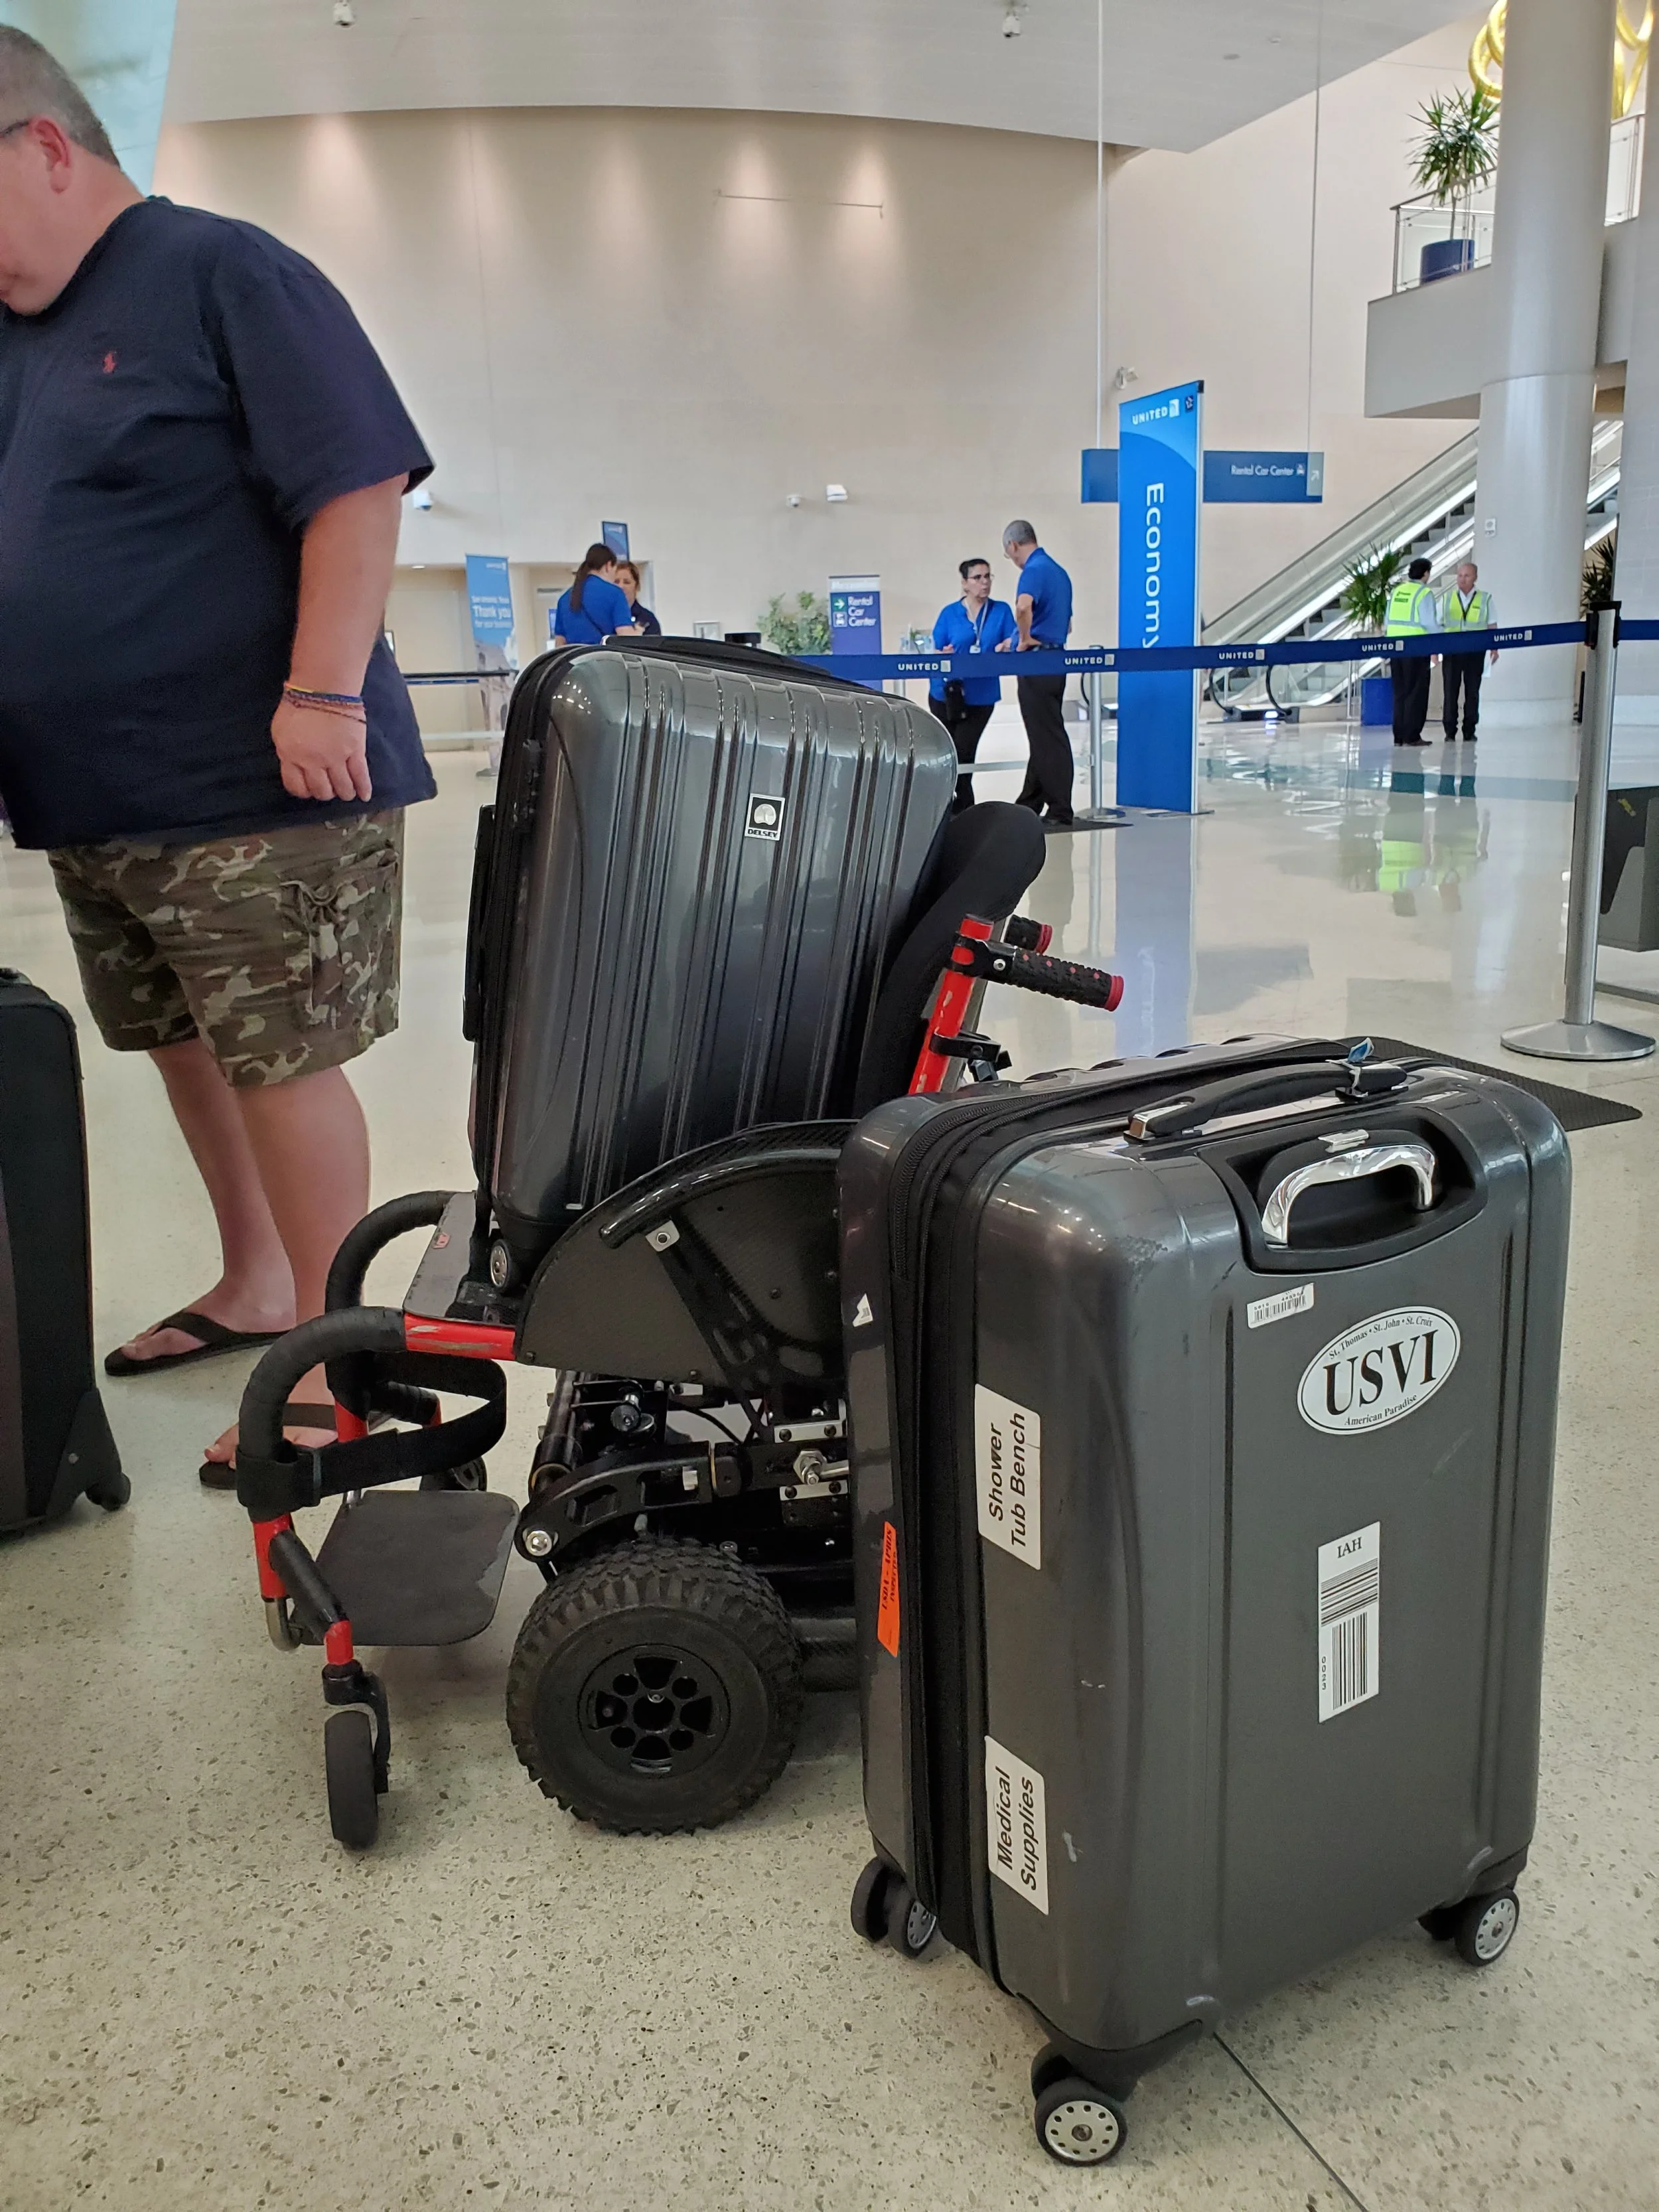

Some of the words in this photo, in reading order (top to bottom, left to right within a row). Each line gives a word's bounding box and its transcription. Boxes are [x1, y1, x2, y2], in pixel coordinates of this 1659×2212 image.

[1132, 406, 1168, 425] UNITED
[1231, 465, 1254, 475] Rental
[1255, 465, 1269, 476] Car
[1270, 465, 1293, 476] Center
[1142, 482, 1164, 648] Economy
[847, 595, 873, 606] Rental
[848, 607, 865, 617] Car
[849, 617, 877, 627] Center
[1494, 633, 1523, 642] UNITED
[1064, 656, 1103, 665] UNITED
[1218, 651, 1254, 660] UNITED
[897, 662, 939, 671] UNITED
[747, 828, 778, 838] DELSEY
[1329, 1350, 1340, 1360] St.
[1339, 1329, 1368, 1352] Thomas
[1373, 1323, 1383, 1333] St.
[1383, 1318, 1400, 1331] John
[1406, 1316, 1415, 1325] St.
[1415, 1315, 1433, 1327] Croix
[1323, 1329, 1439, 1416] USVI
[1344, 1413, 1382, 1426] American
[1384, 1394, 1417, 1418] Paradise
[1009, 1412, 1025, 1497] Bench
[989, 1422, 1003, 1521] Shower
[1011, 1503, 1026, 1547] Tub
[1337, 1536, 1362, 1558] IAH
[995, 1765, 1013, 1871] Medical
[1019, 1776, 1040, 1891] Supplies
